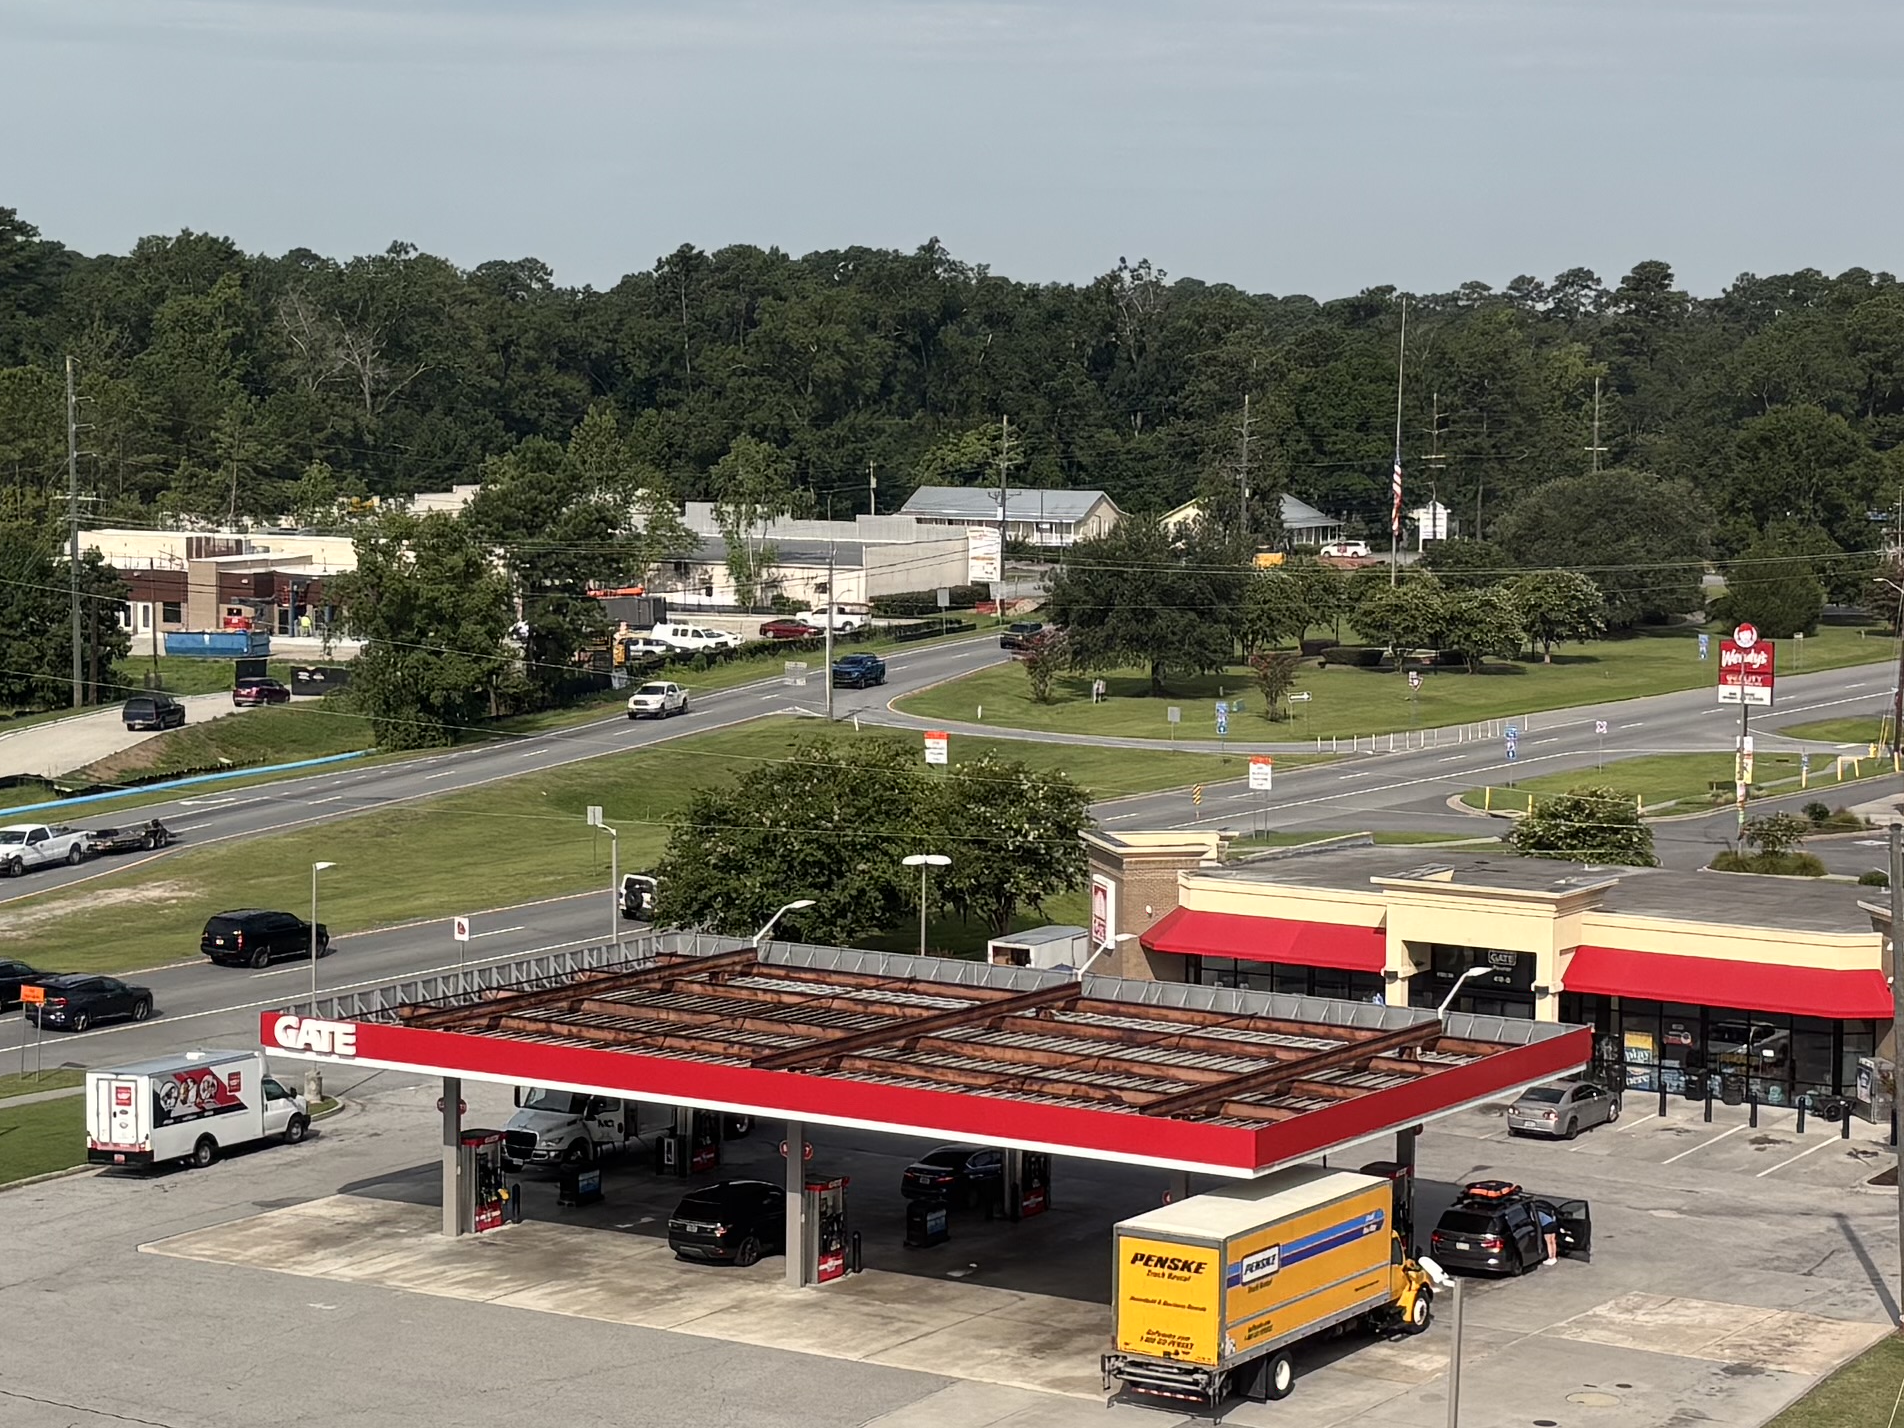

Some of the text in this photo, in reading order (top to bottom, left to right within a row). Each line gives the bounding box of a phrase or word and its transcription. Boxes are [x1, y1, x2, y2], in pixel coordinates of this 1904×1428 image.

[274, 1015, 357, 1056] GATE
[1130, 1252, 1208, 1275] PENSKE
[1244, 1254, 1277, 1276] PENSKE
